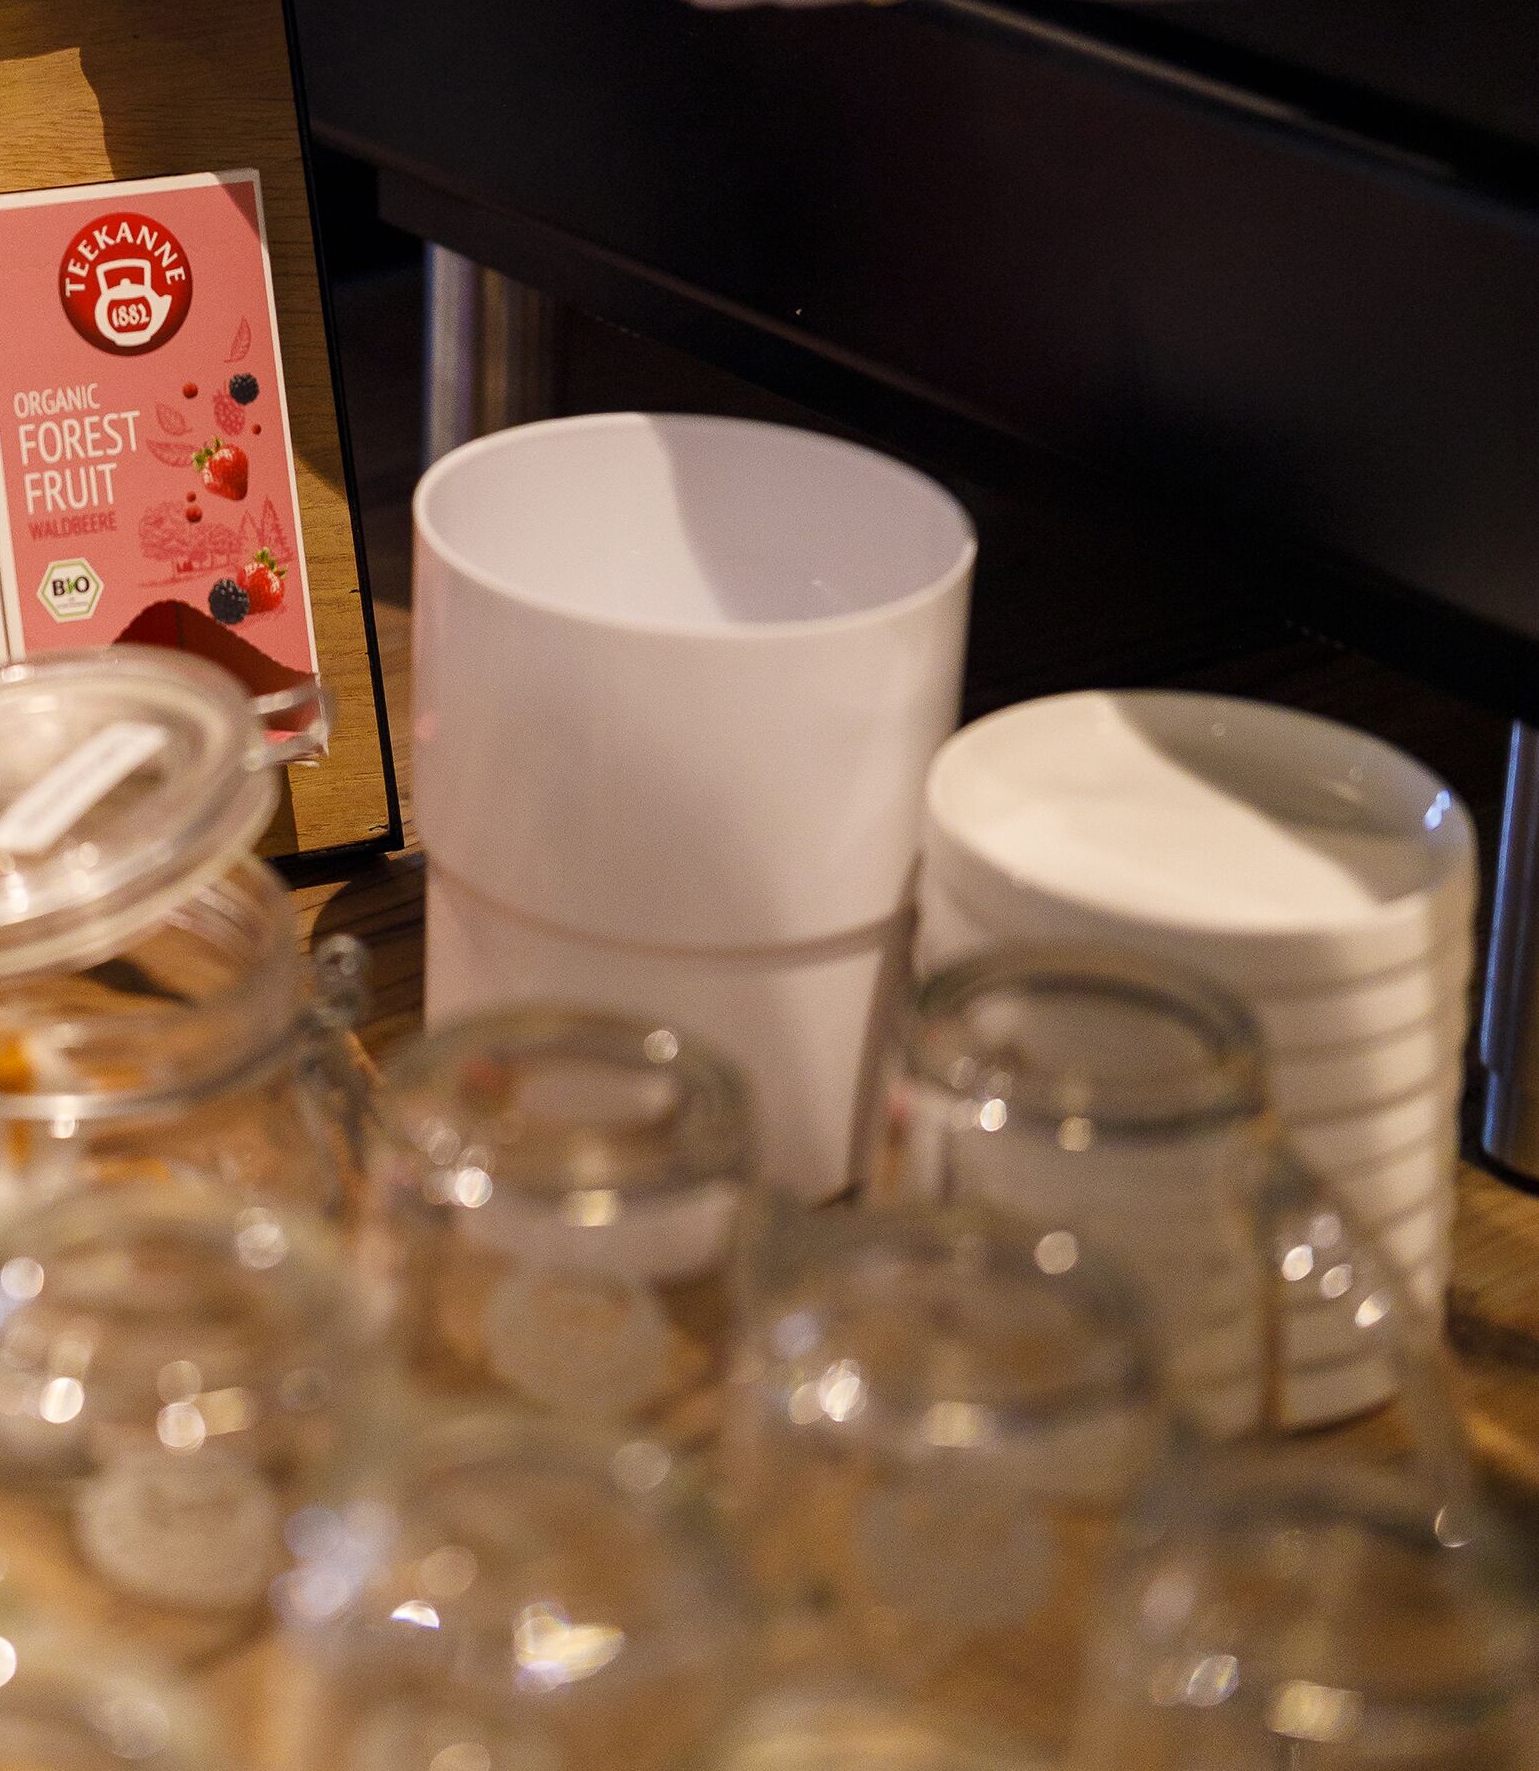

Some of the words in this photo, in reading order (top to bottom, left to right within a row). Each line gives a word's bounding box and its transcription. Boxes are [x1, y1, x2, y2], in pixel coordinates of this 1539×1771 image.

[64, 221, 187, 298] TEEKANNE
[112, 303, 151, 328] 1882
[13, 382, 101, 419] ORGANIC
[18, 410, 141, 467] FOREST
[23, 461, 118, 516] FRUIT
[27, 510, 117, 541] WALDBEERE
